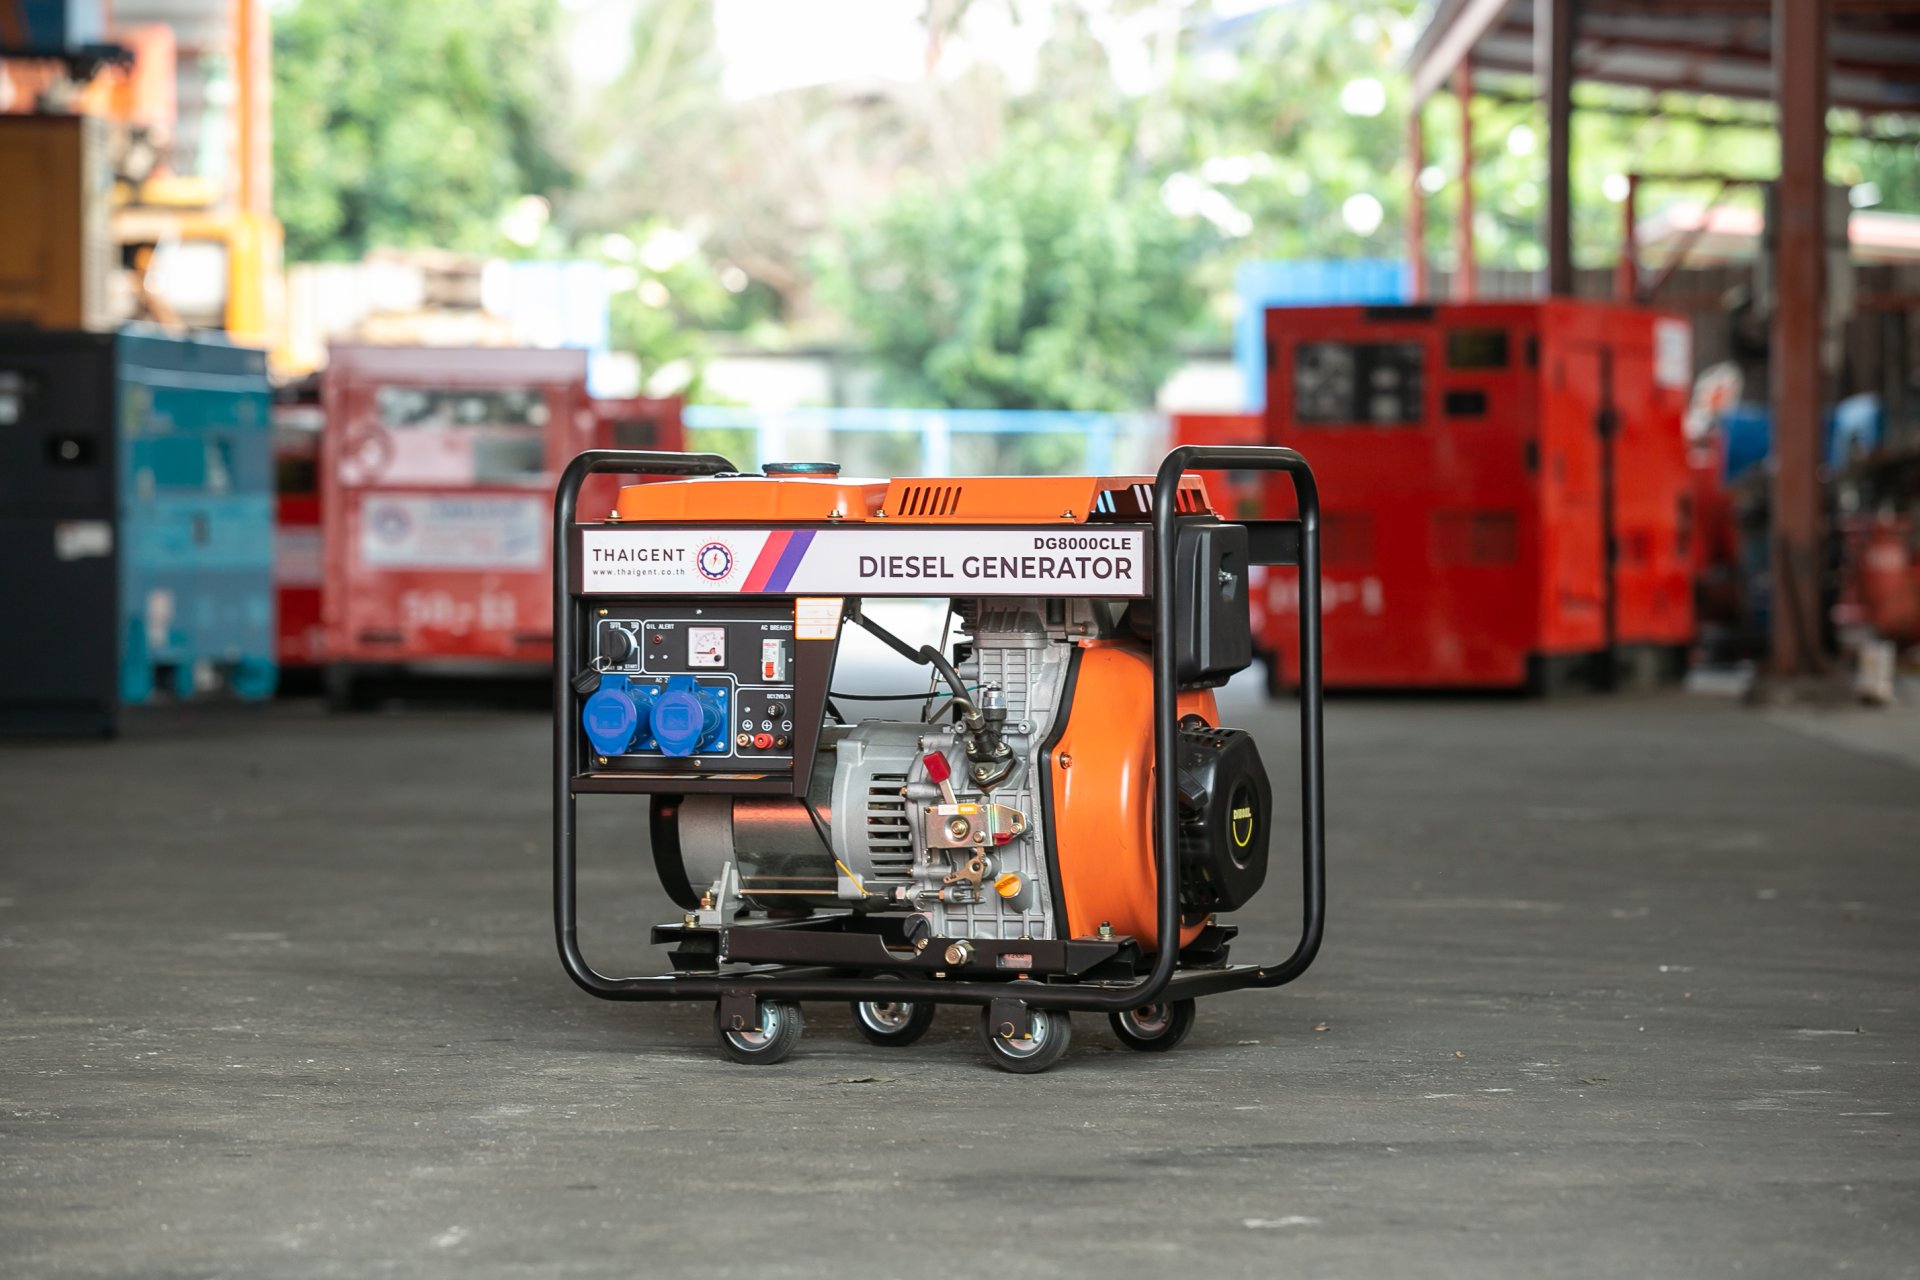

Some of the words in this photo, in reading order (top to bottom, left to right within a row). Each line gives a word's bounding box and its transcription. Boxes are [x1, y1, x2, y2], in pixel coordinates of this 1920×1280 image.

[1033, 537, 1132, 550] DG8000CLE
[592, 548, 685, 562] THAIGENT
[592, 568, 685, 577] www.thaigent.co.th
[859, 555, 954, 578] DIESEL
[962, 556, 1133, 580] GENERATOR
